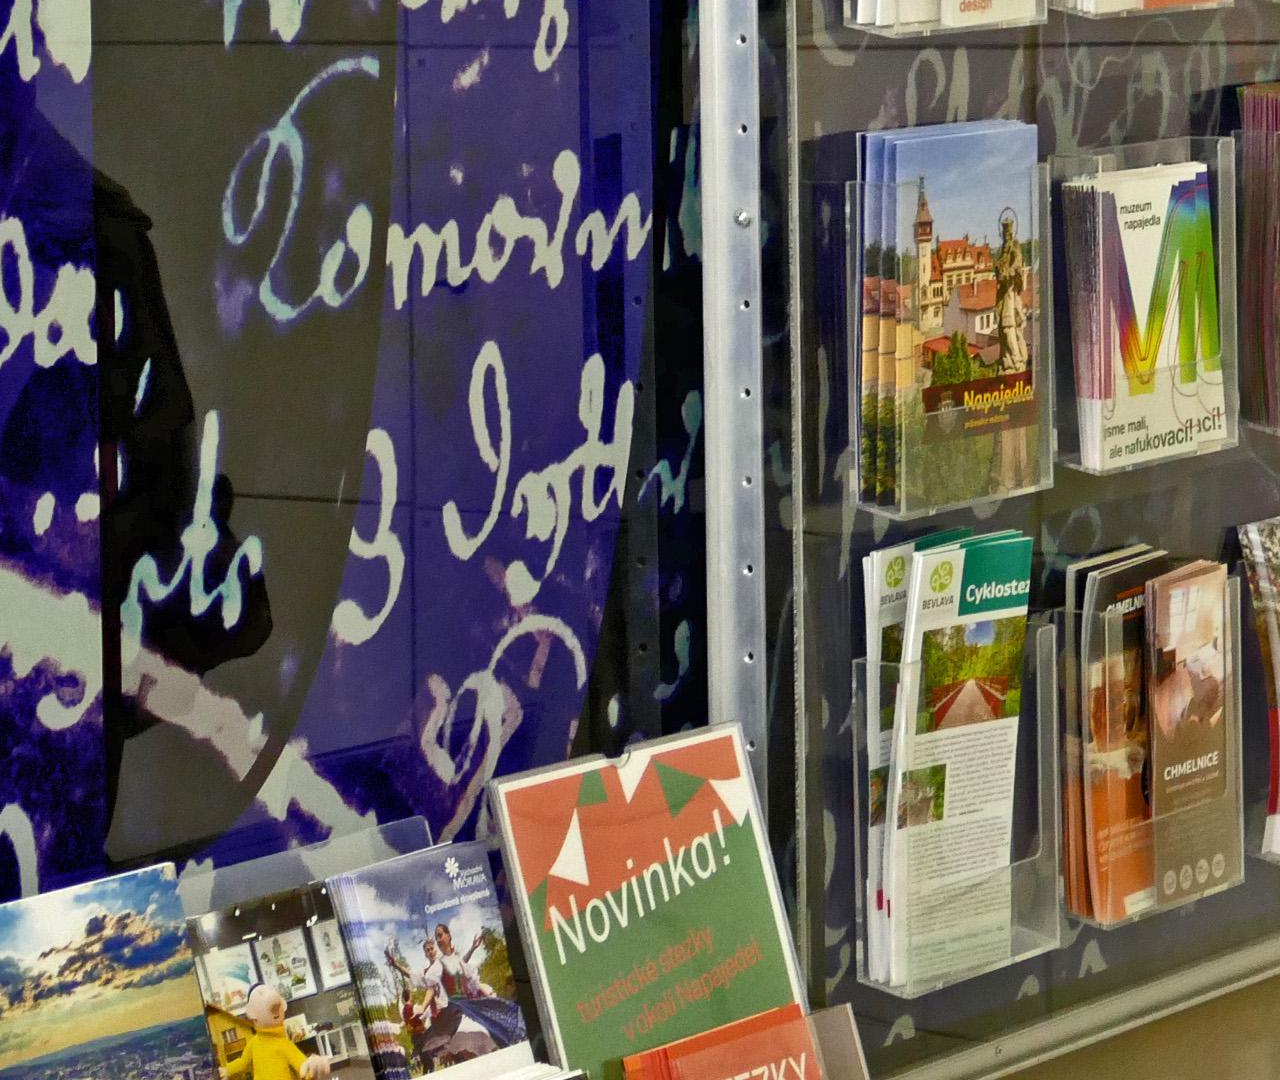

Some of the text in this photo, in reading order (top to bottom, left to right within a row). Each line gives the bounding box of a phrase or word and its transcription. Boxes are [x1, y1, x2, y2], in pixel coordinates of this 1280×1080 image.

[1120, 201, 1152, 215] muzeum
[963, 380, 1034, 414] Napajedla
[1124, 418, 1194, 456] nafukovací!
[922, 594, 955, 611] BEVLAVA
[1163, 750, 1220, 781] CHMELNICE
[548, 808, 732, 966] Novinka!
[575, 923, 714, 1024] turistické stezky
[623, 1023, 637, 1043] v
